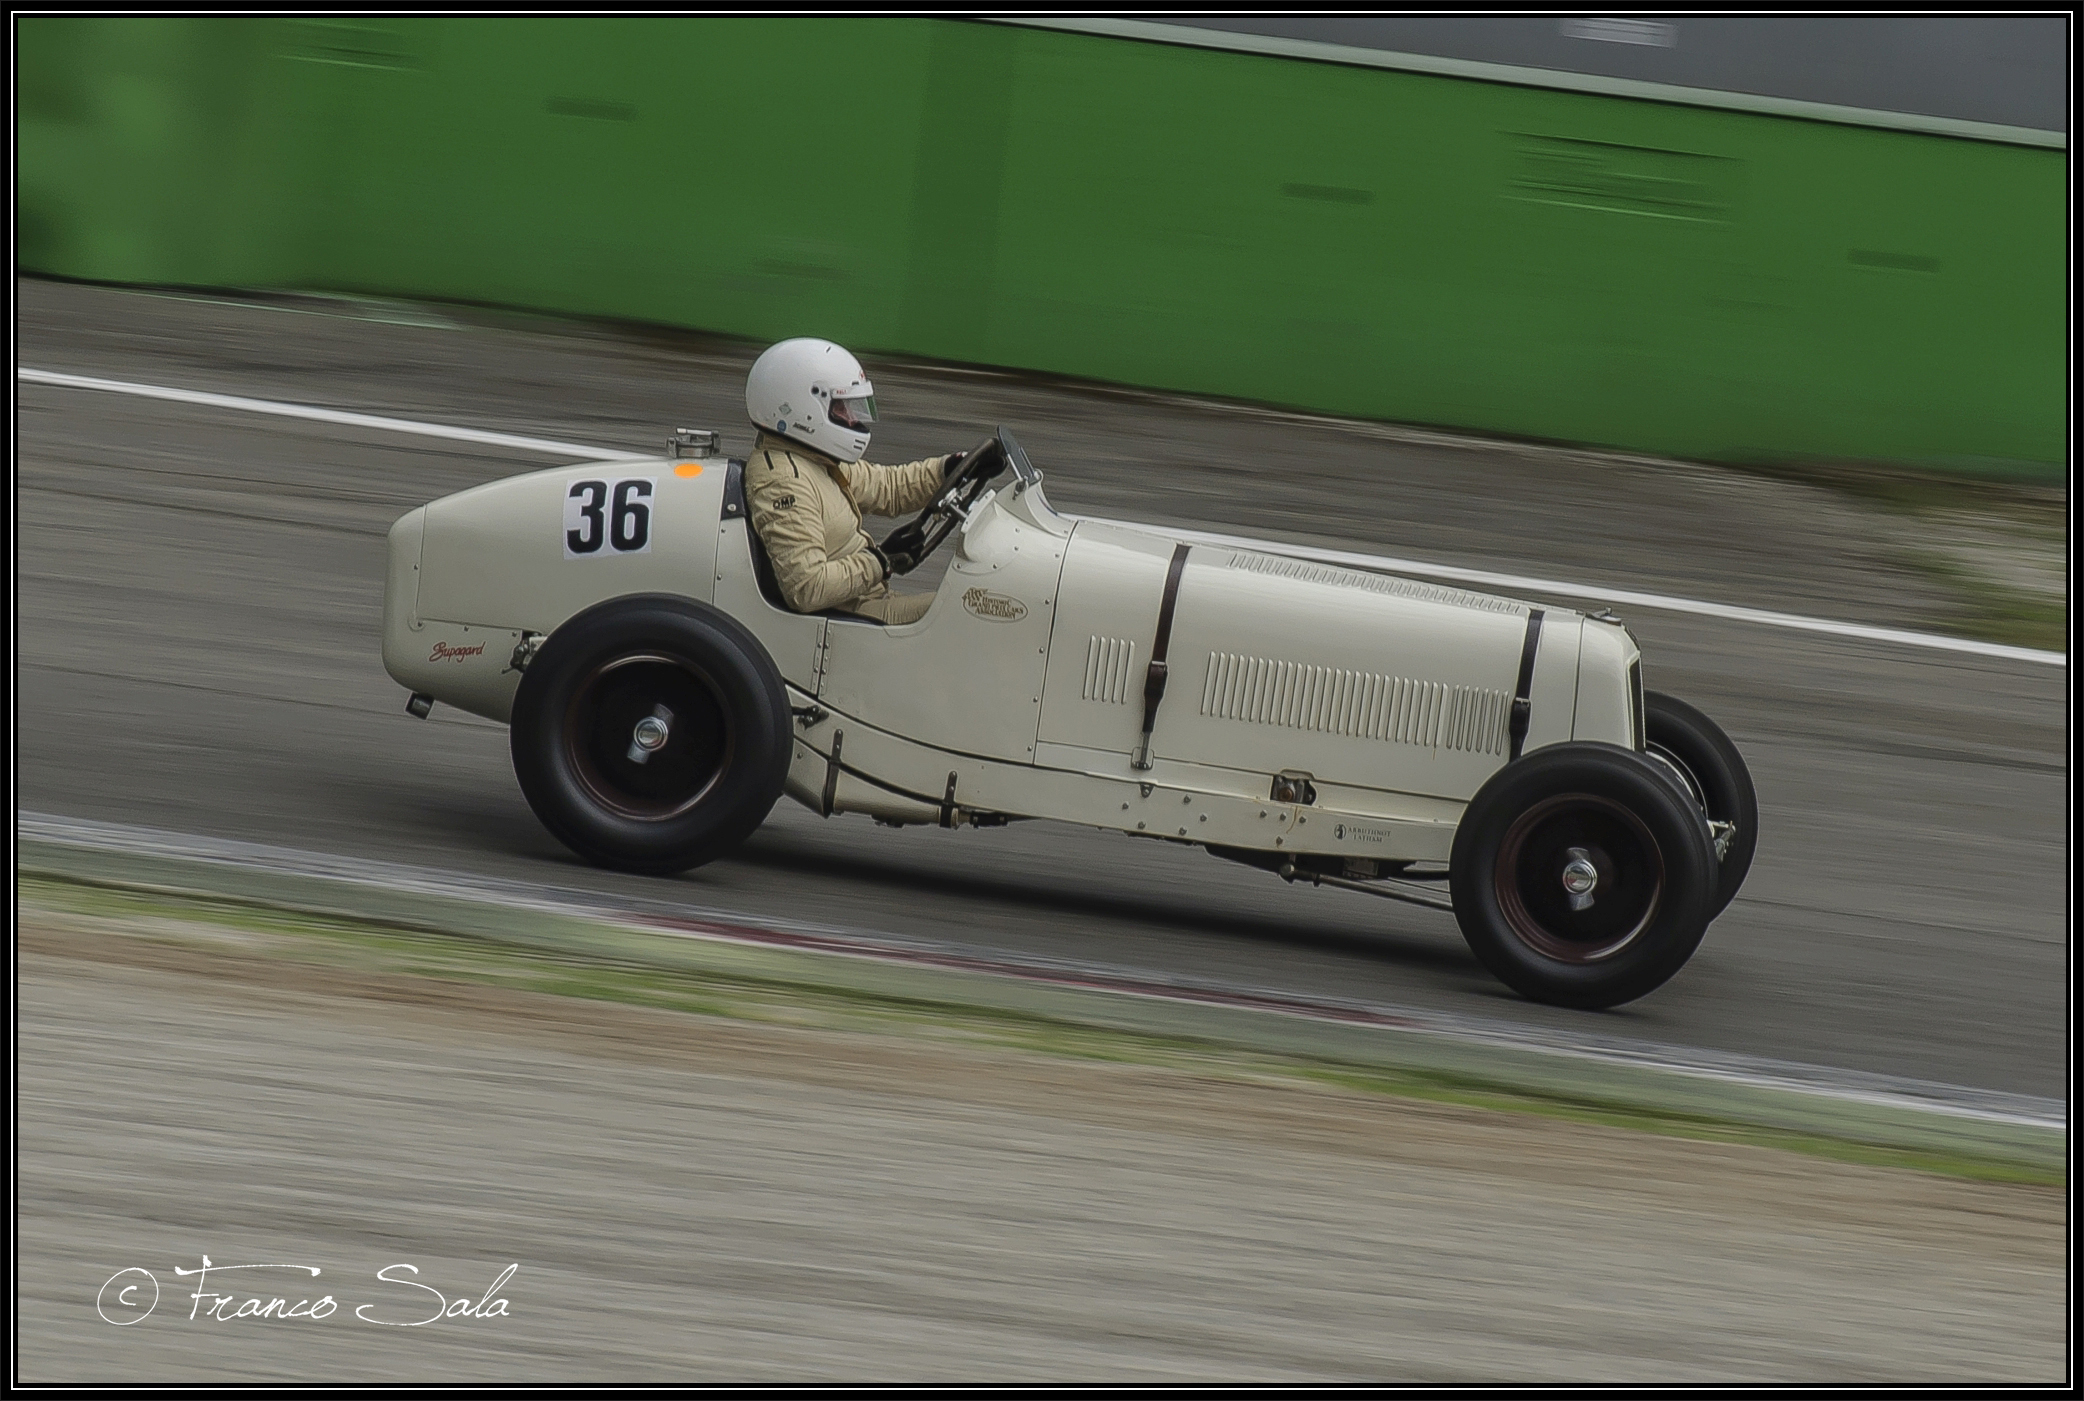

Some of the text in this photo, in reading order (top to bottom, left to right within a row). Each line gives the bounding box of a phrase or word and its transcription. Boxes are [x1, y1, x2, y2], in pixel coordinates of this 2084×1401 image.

[772, 494, 796, 510] OMP
[567, 480, 653, 554] 36
[429, 641, 486, 663] Supagard
